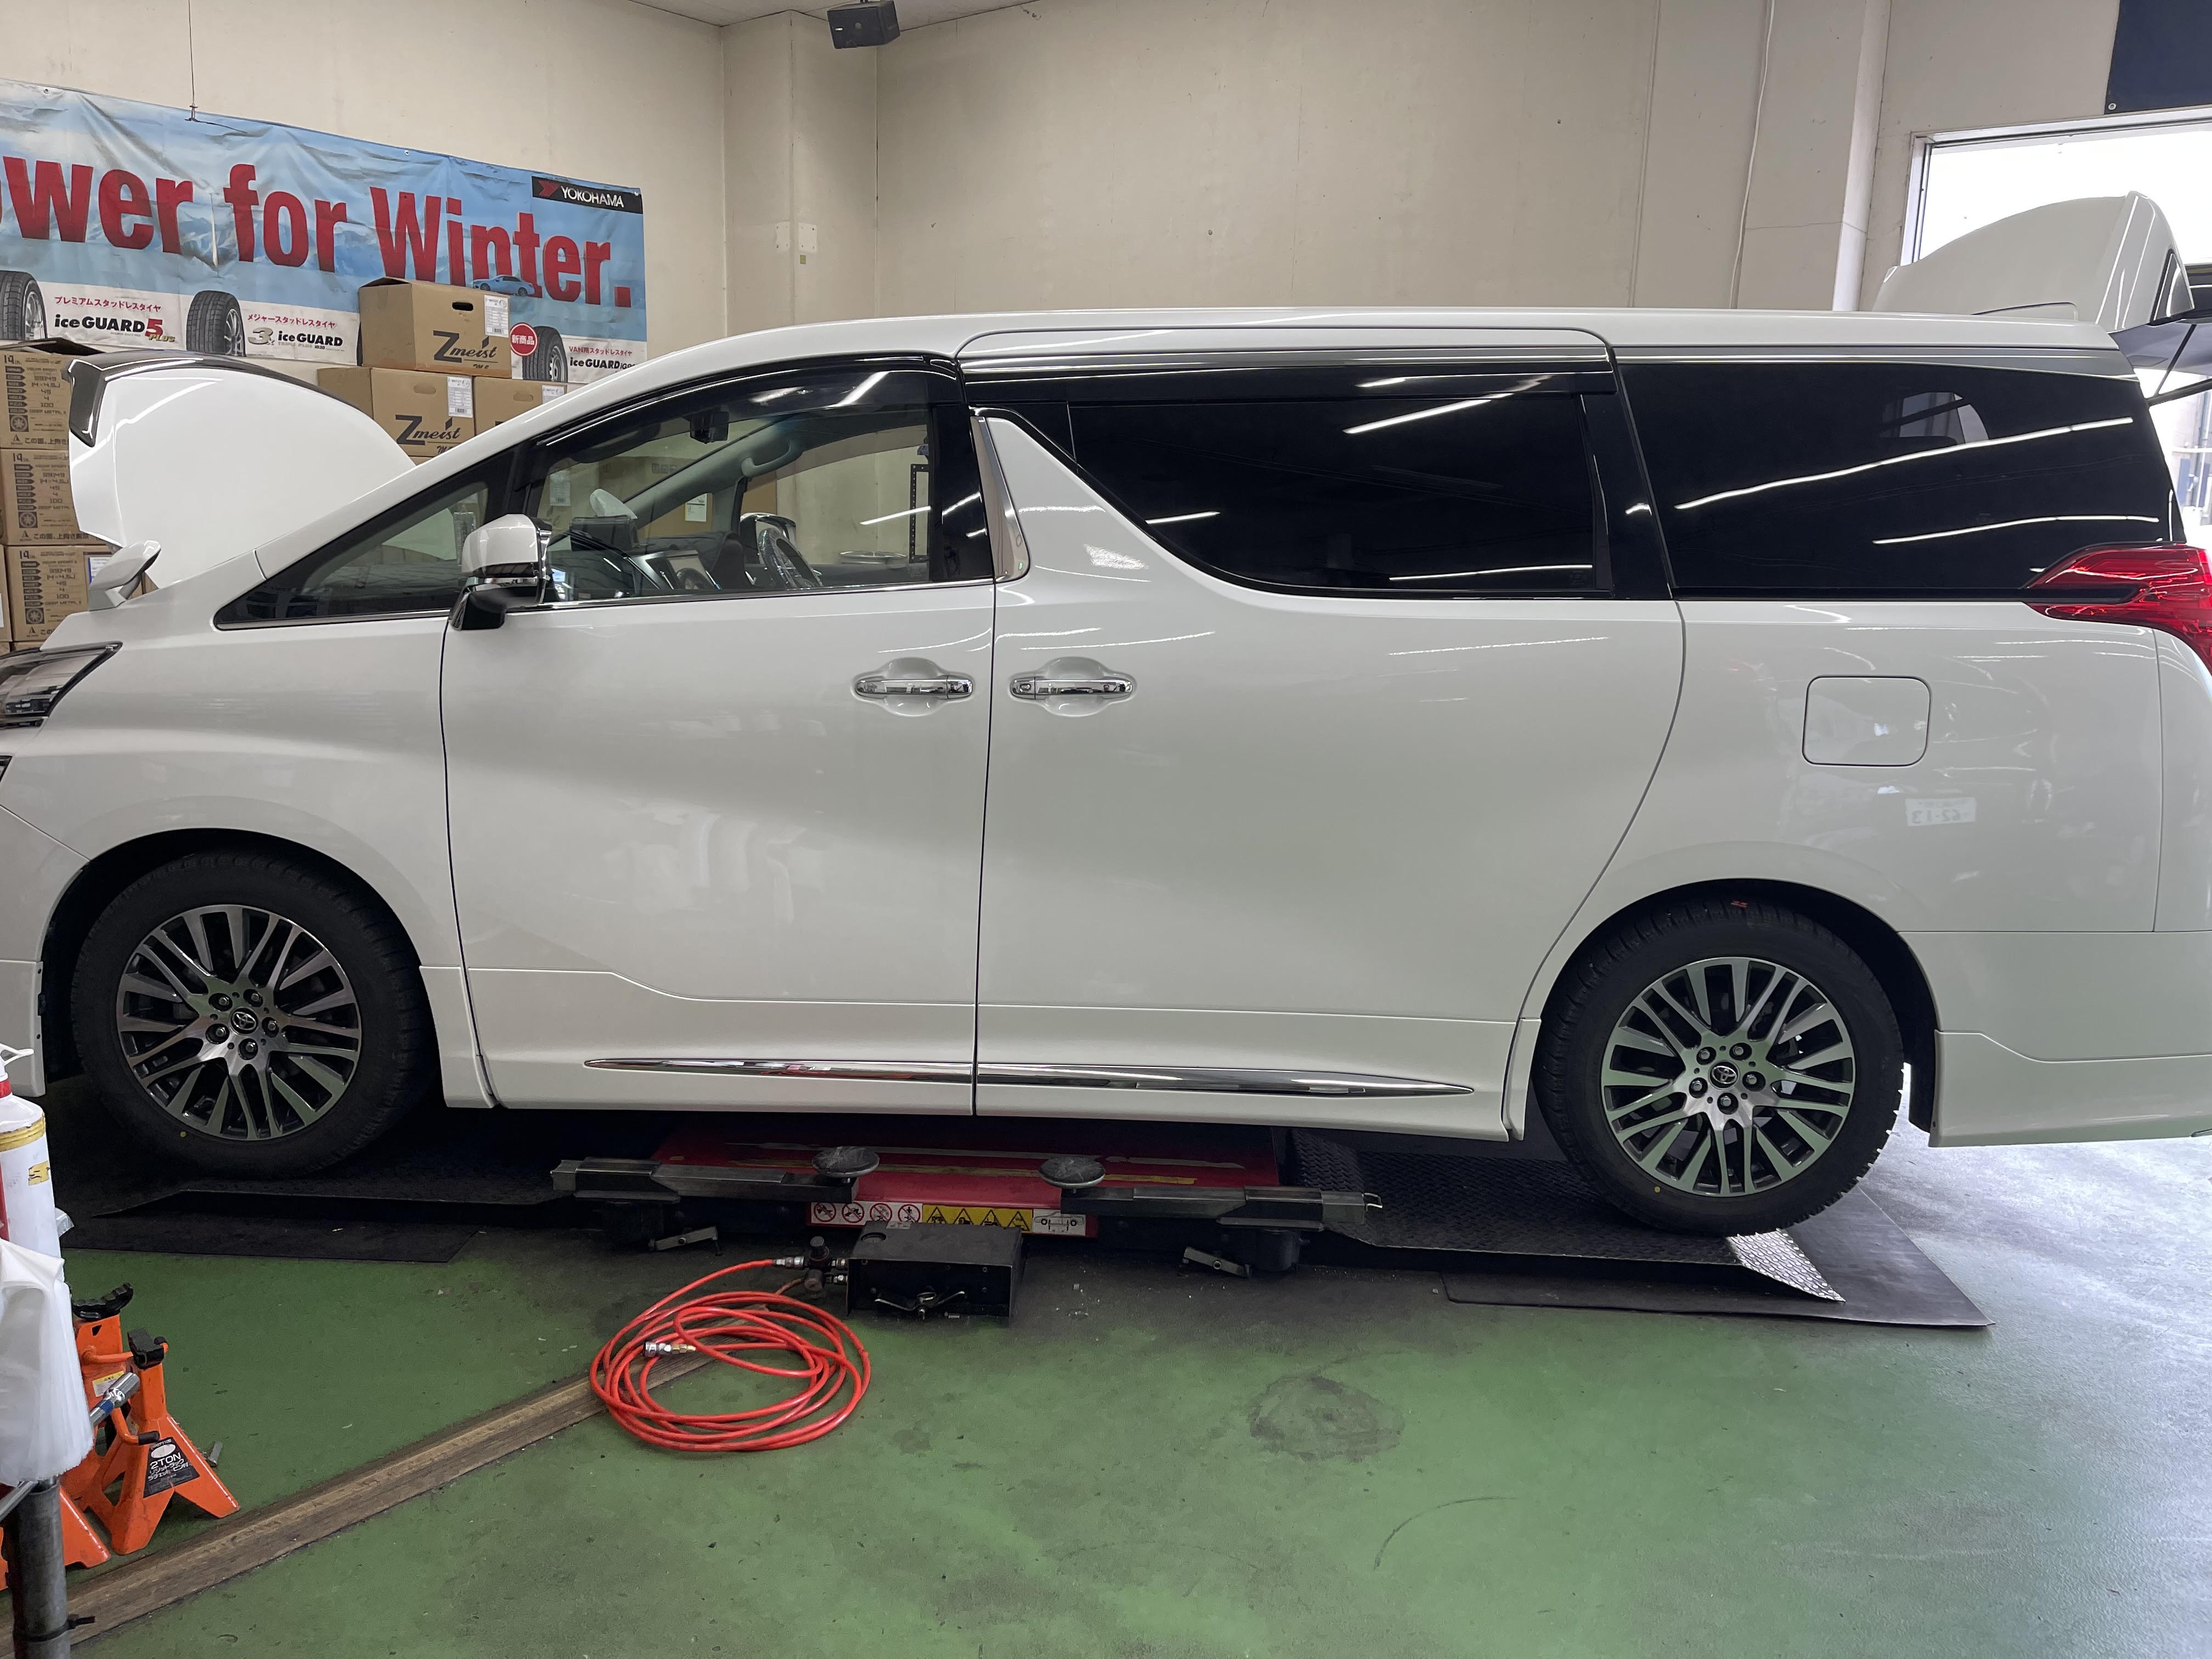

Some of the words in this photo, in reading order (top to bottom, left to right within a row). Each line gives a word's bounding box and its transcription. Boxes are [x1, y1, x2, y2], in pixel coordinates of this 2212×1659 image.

[561, 185, 624, 208] YOKOHAMA
[0, 156, 193, 255] wer
[223, 163, 347, 273] for
[369, 187, 631, 308] Winter.
[54, 296, 161, 312] プレミアムスタッドレスタイヤ
[247, 314, 336, 329] メジャースタッドレスタイヤ
[511, 334, 535, 346] 新商品
[150, 1452, 181, 1469] 2TON
